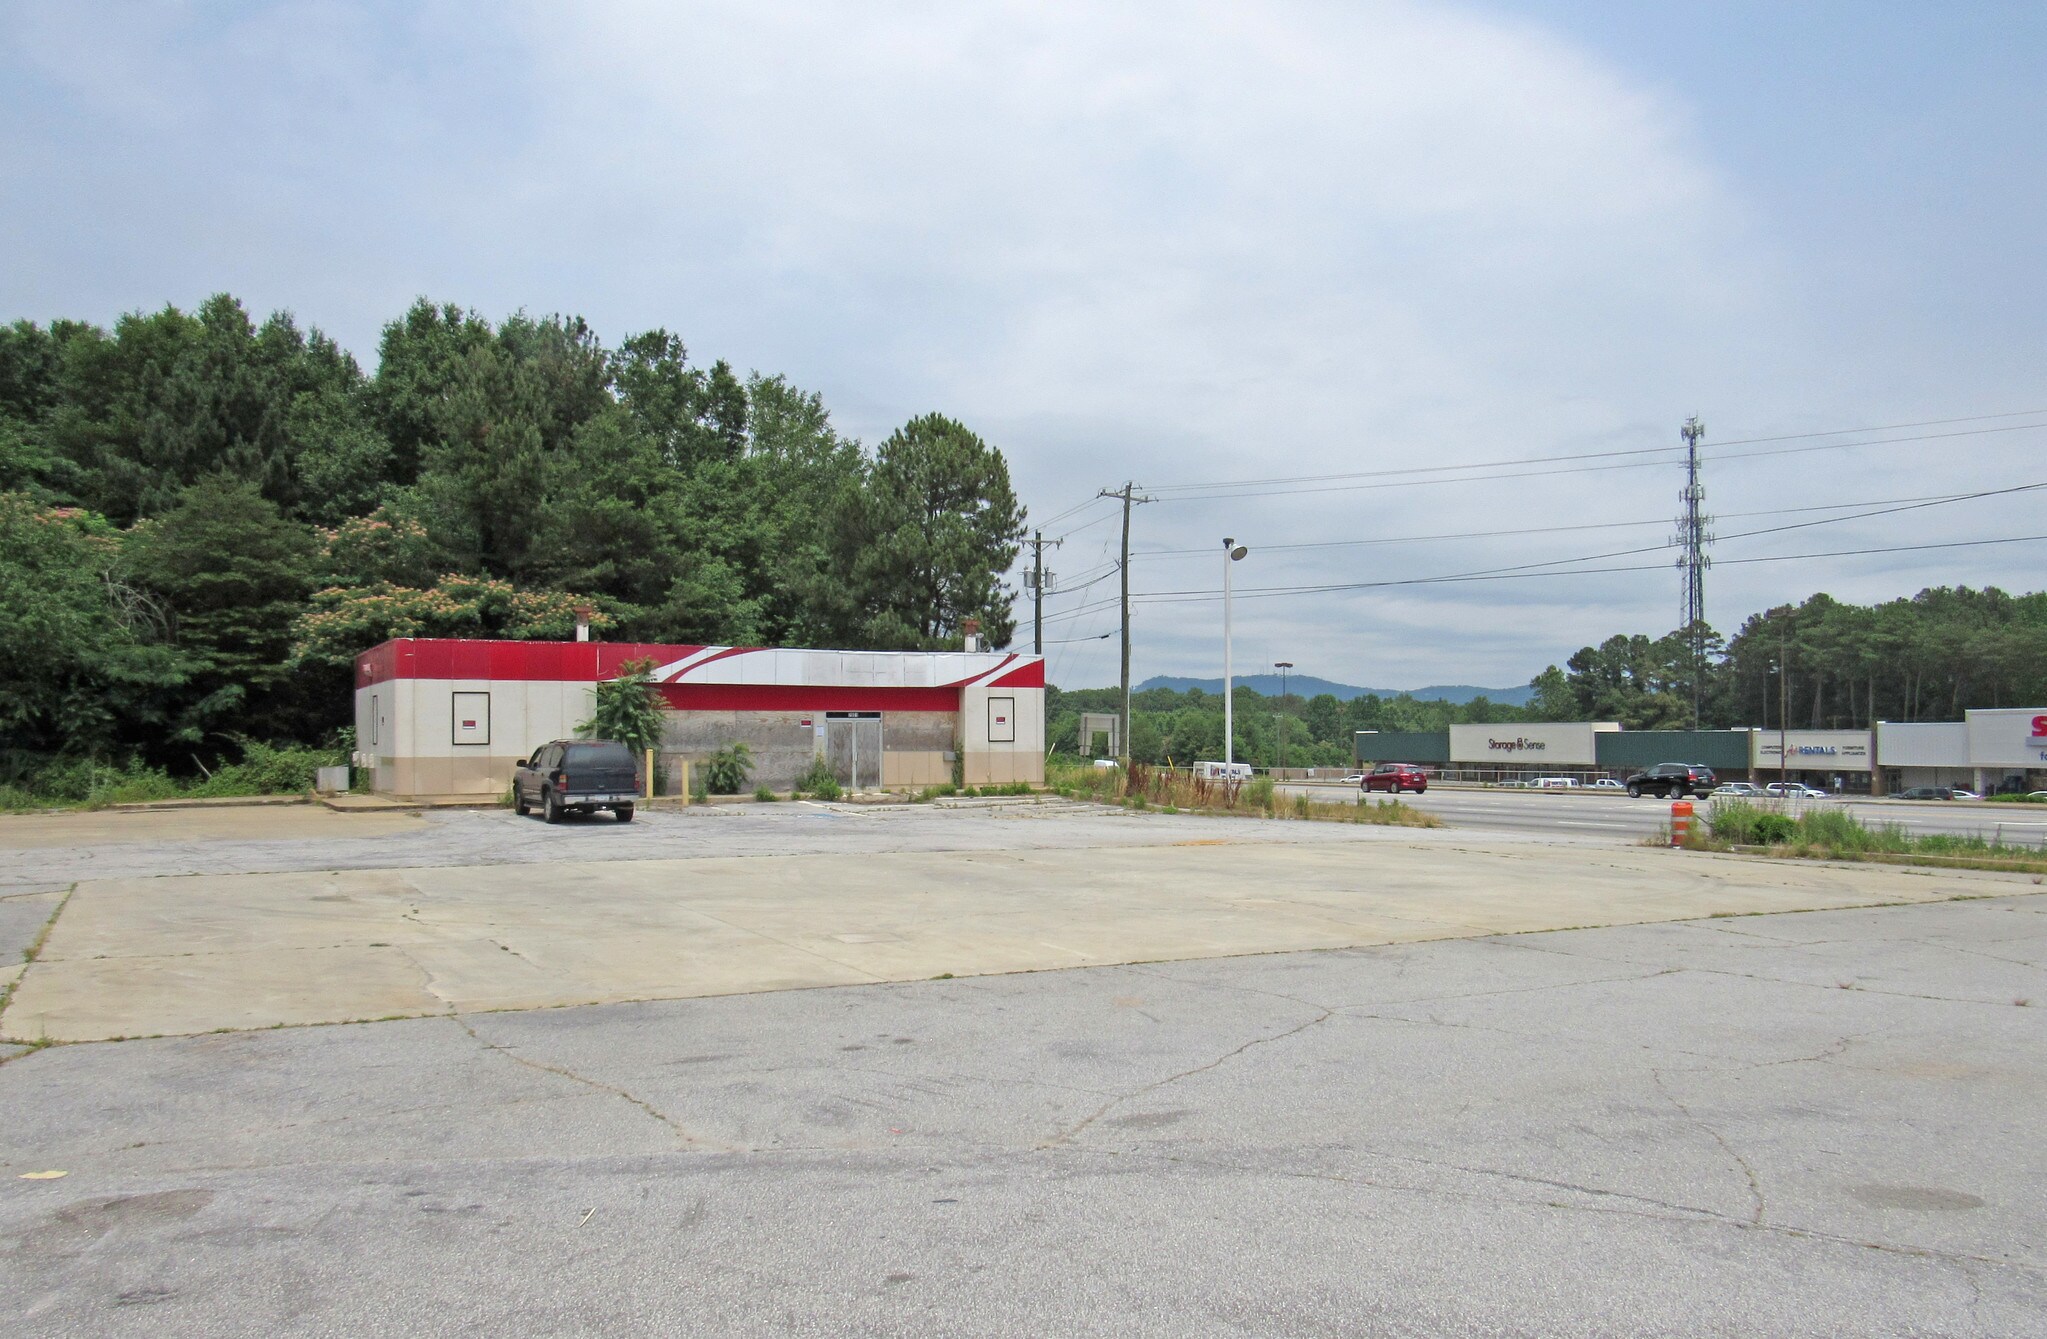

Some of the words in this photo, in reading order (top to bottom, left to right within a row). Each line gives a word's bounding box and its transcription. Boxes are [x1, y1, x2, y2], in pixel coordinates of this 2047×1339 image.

[1488, 738, 1516, 752] Storage
[1523, 738, 1546, 750] Sense
[1798, 746, 1836, 755] RENTALS
